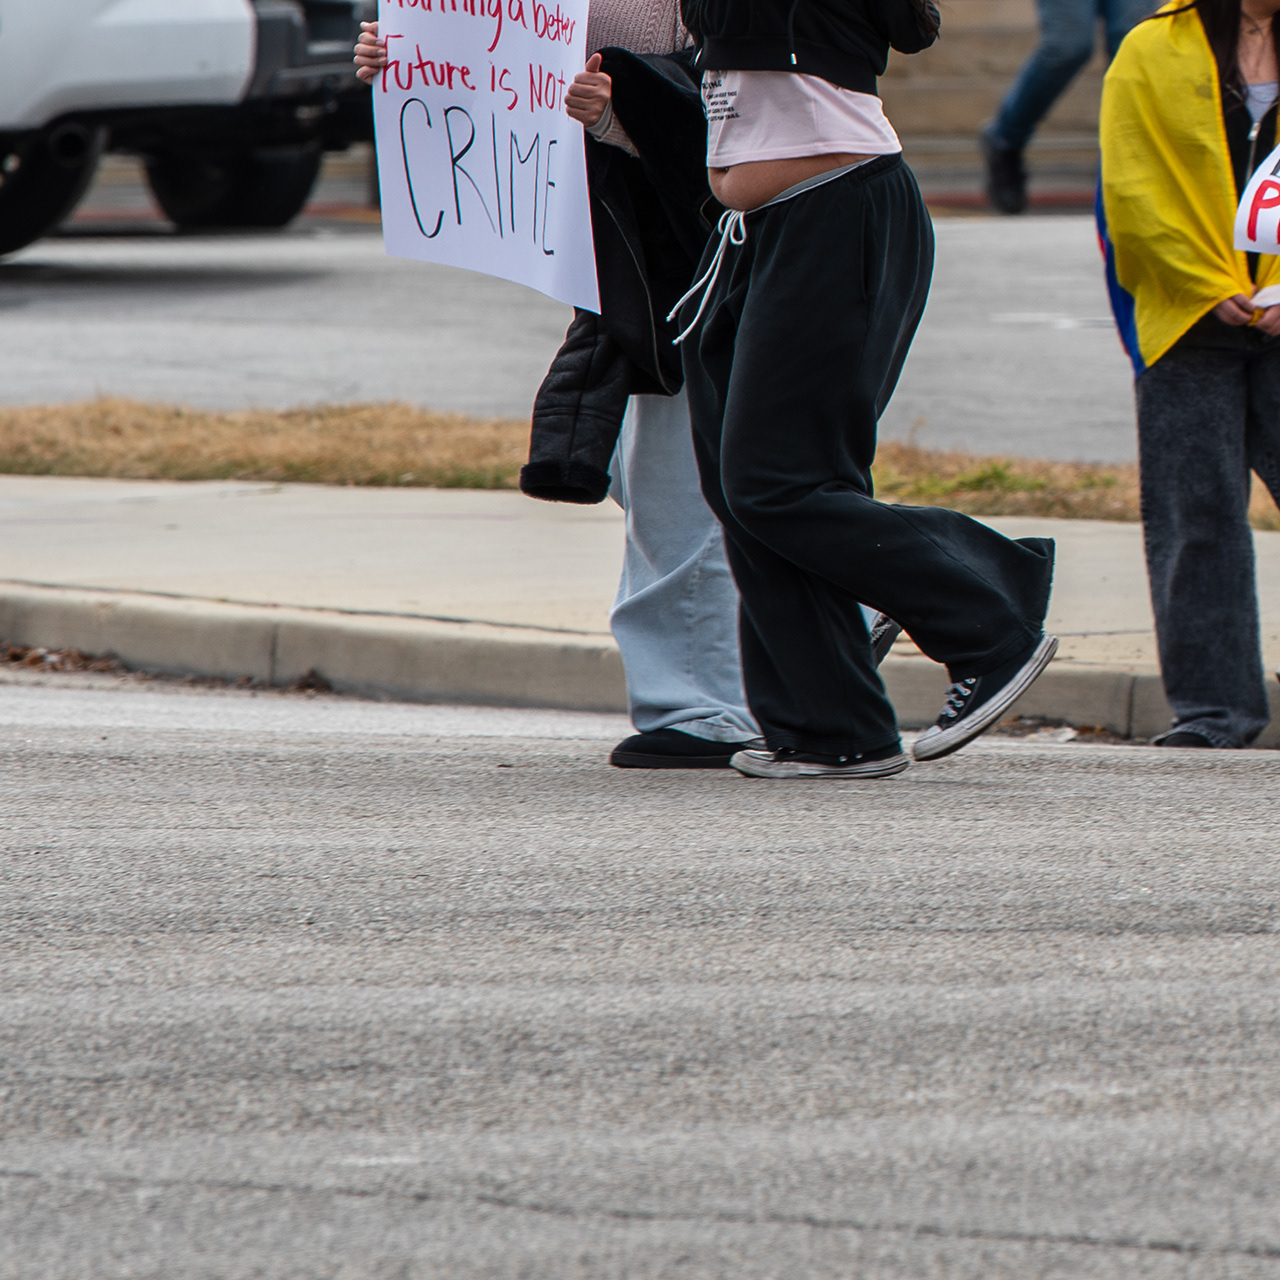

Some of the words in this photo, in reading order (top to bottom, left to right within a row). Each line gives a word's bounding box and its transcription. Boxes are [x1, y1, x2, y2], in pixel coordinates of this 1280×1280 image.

[381, 34, 477, 94] Future
[489, 60, 518, 111] is
[400, 97, 558, 256] CRIME
